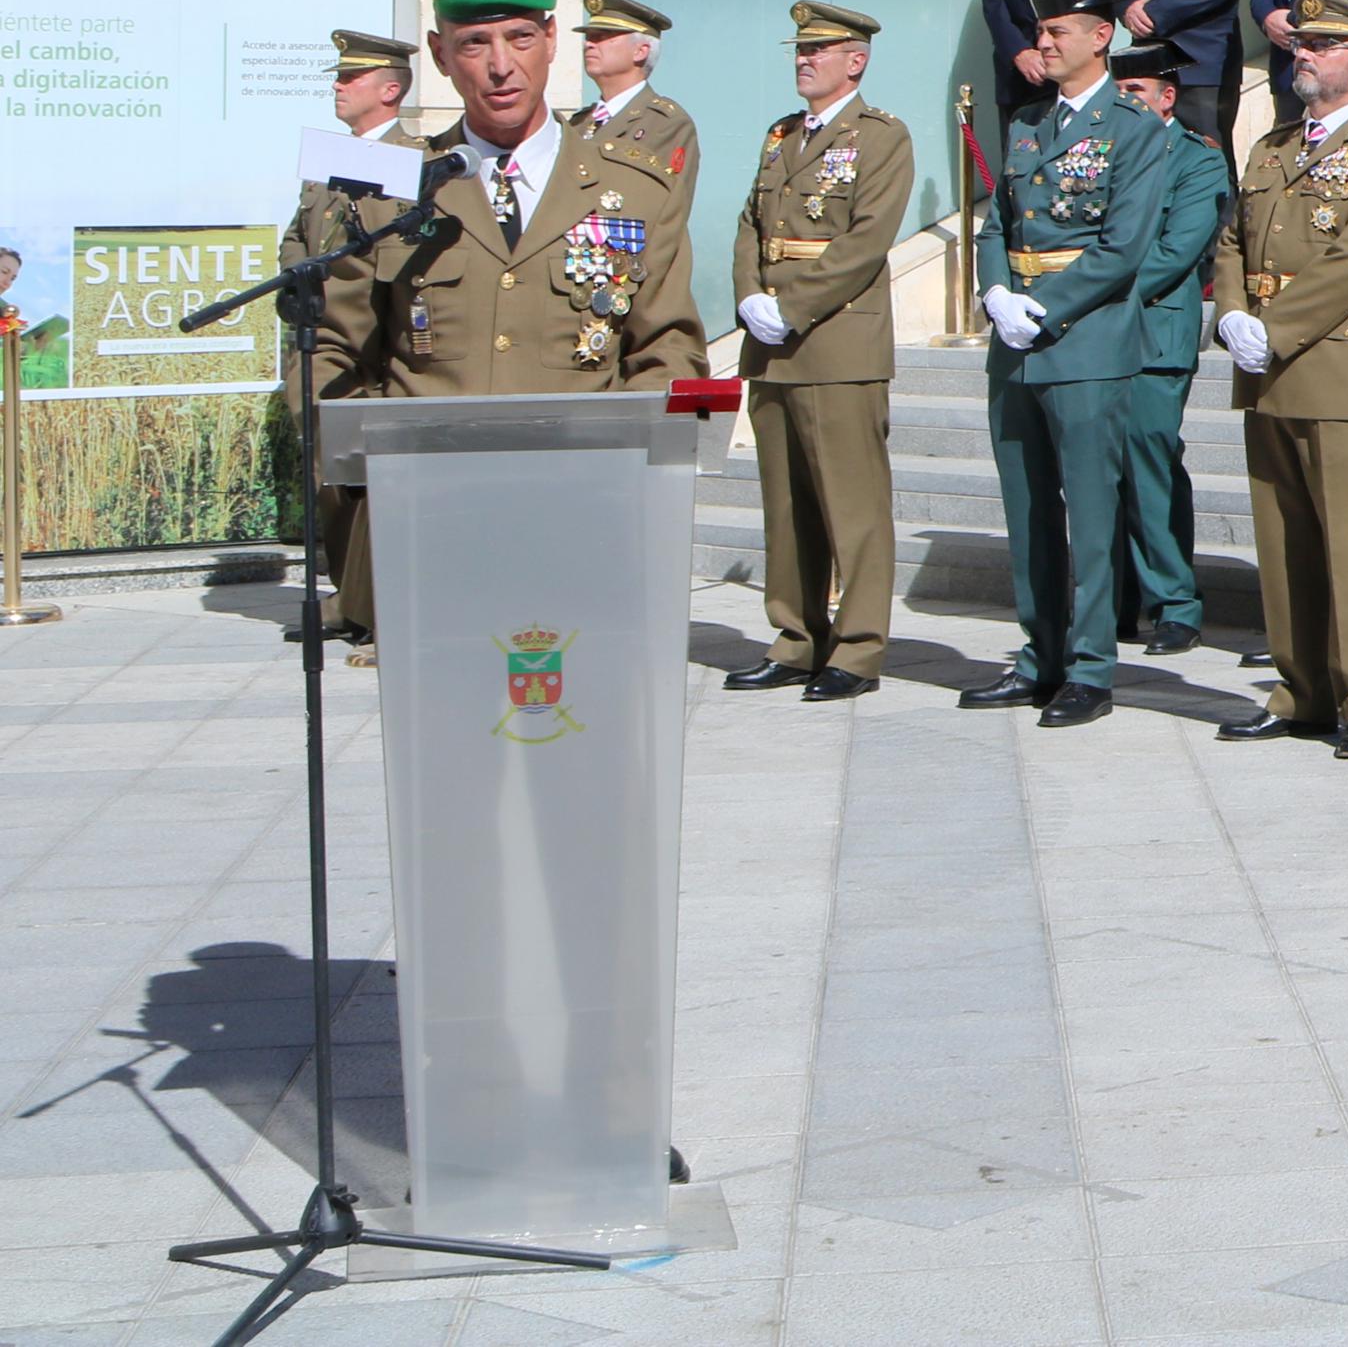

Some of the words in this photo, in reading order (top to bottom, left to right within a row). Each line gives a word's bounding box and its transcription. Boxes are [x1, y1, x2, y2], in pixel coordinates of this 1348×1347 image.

[80, 15, 135, 37] parte
[29, 41, 120, 63] cambio,
[242, 40, 277, 50] Accede
[242, 56, 307, 67] especializado
[309, 59, 315, 68] y
[13, 69, 168, 94] digitalización
[257, 71, 266, 81] el
[269, 73, 299, 83] mayor
[241, 86, 254, 96] de
[257, 86, 310, 97] innovación
[6, 96, 26, 117] la
[35, 97, 162, 118] innovación
[85, 244, 263, 284] SIENTE
[101, 288, 246, 329] AGRO
